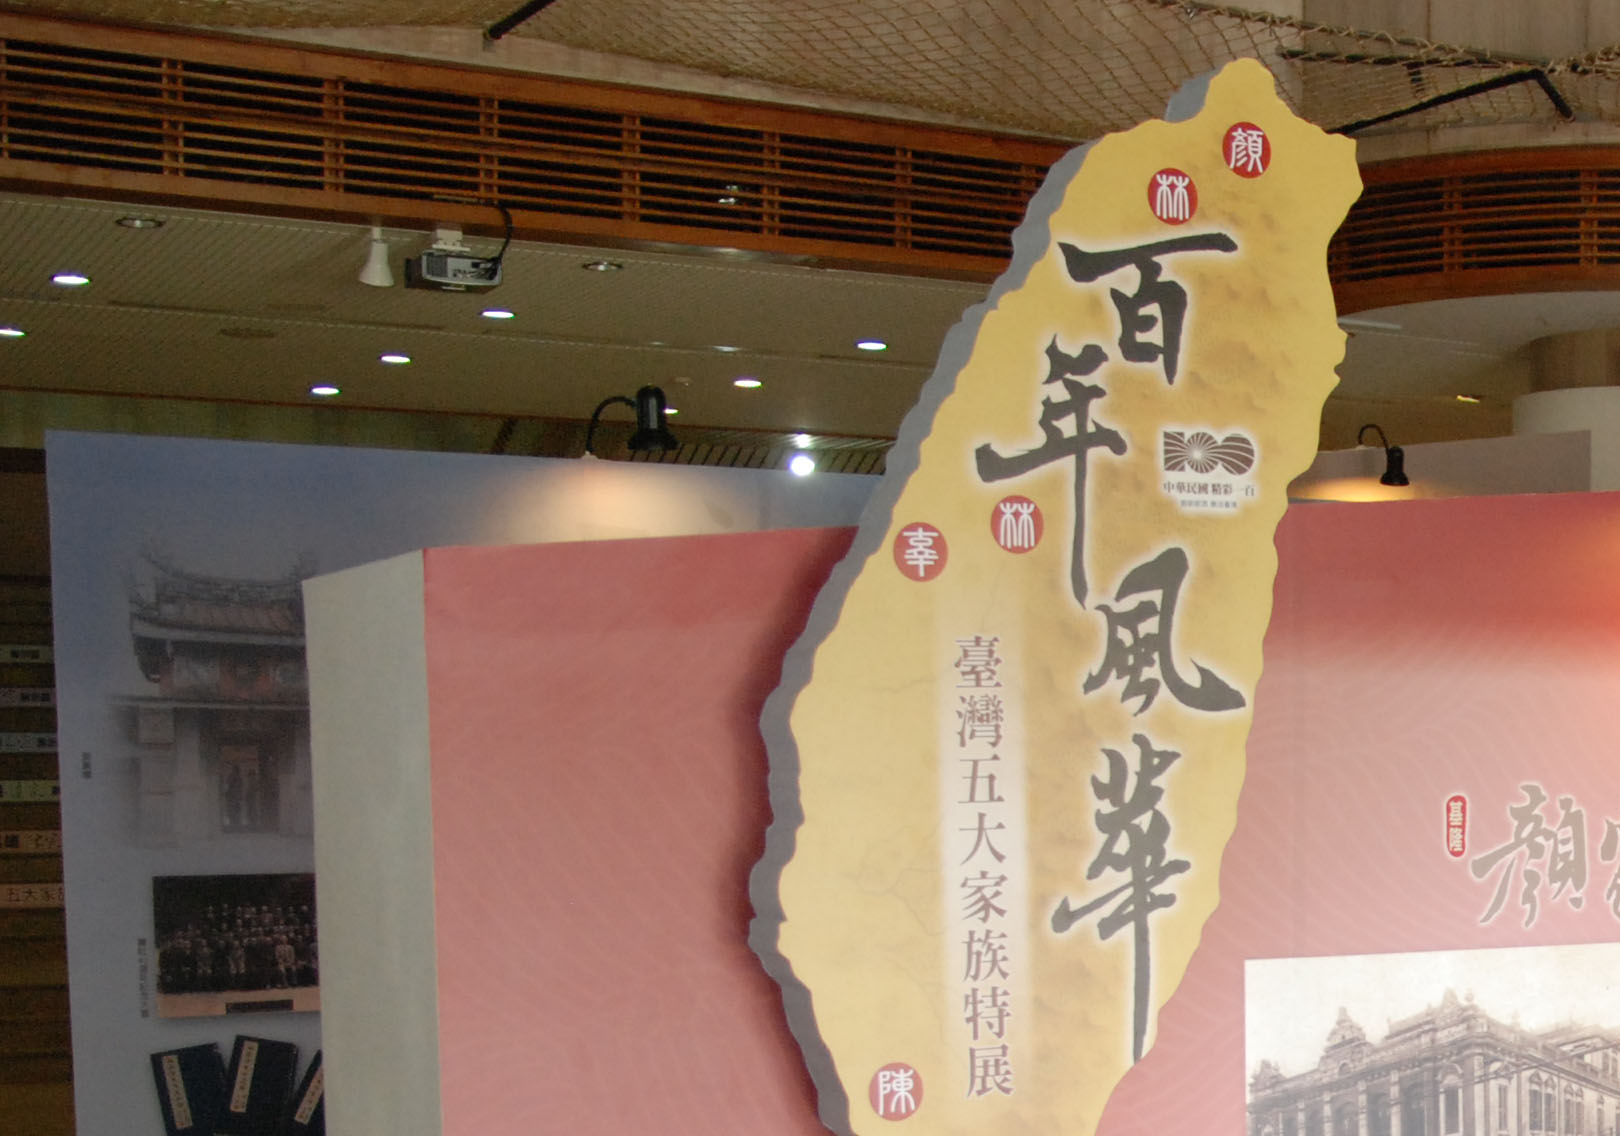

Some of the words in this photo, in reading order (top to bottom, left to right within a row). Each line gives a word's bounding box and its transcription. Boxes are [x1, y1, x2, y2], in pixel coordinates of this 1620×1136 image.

[1230, 127, 1264, 173] 顏
[1156, 174, 1190, 220] 林
[1000, 502, 1036, 548] 林
[975, 232, 1246, 1067] 百年風華
[954, 635, 1013, 1100] 臺灣五大家族特展
[878, 1069, 917, 1115] 陳
